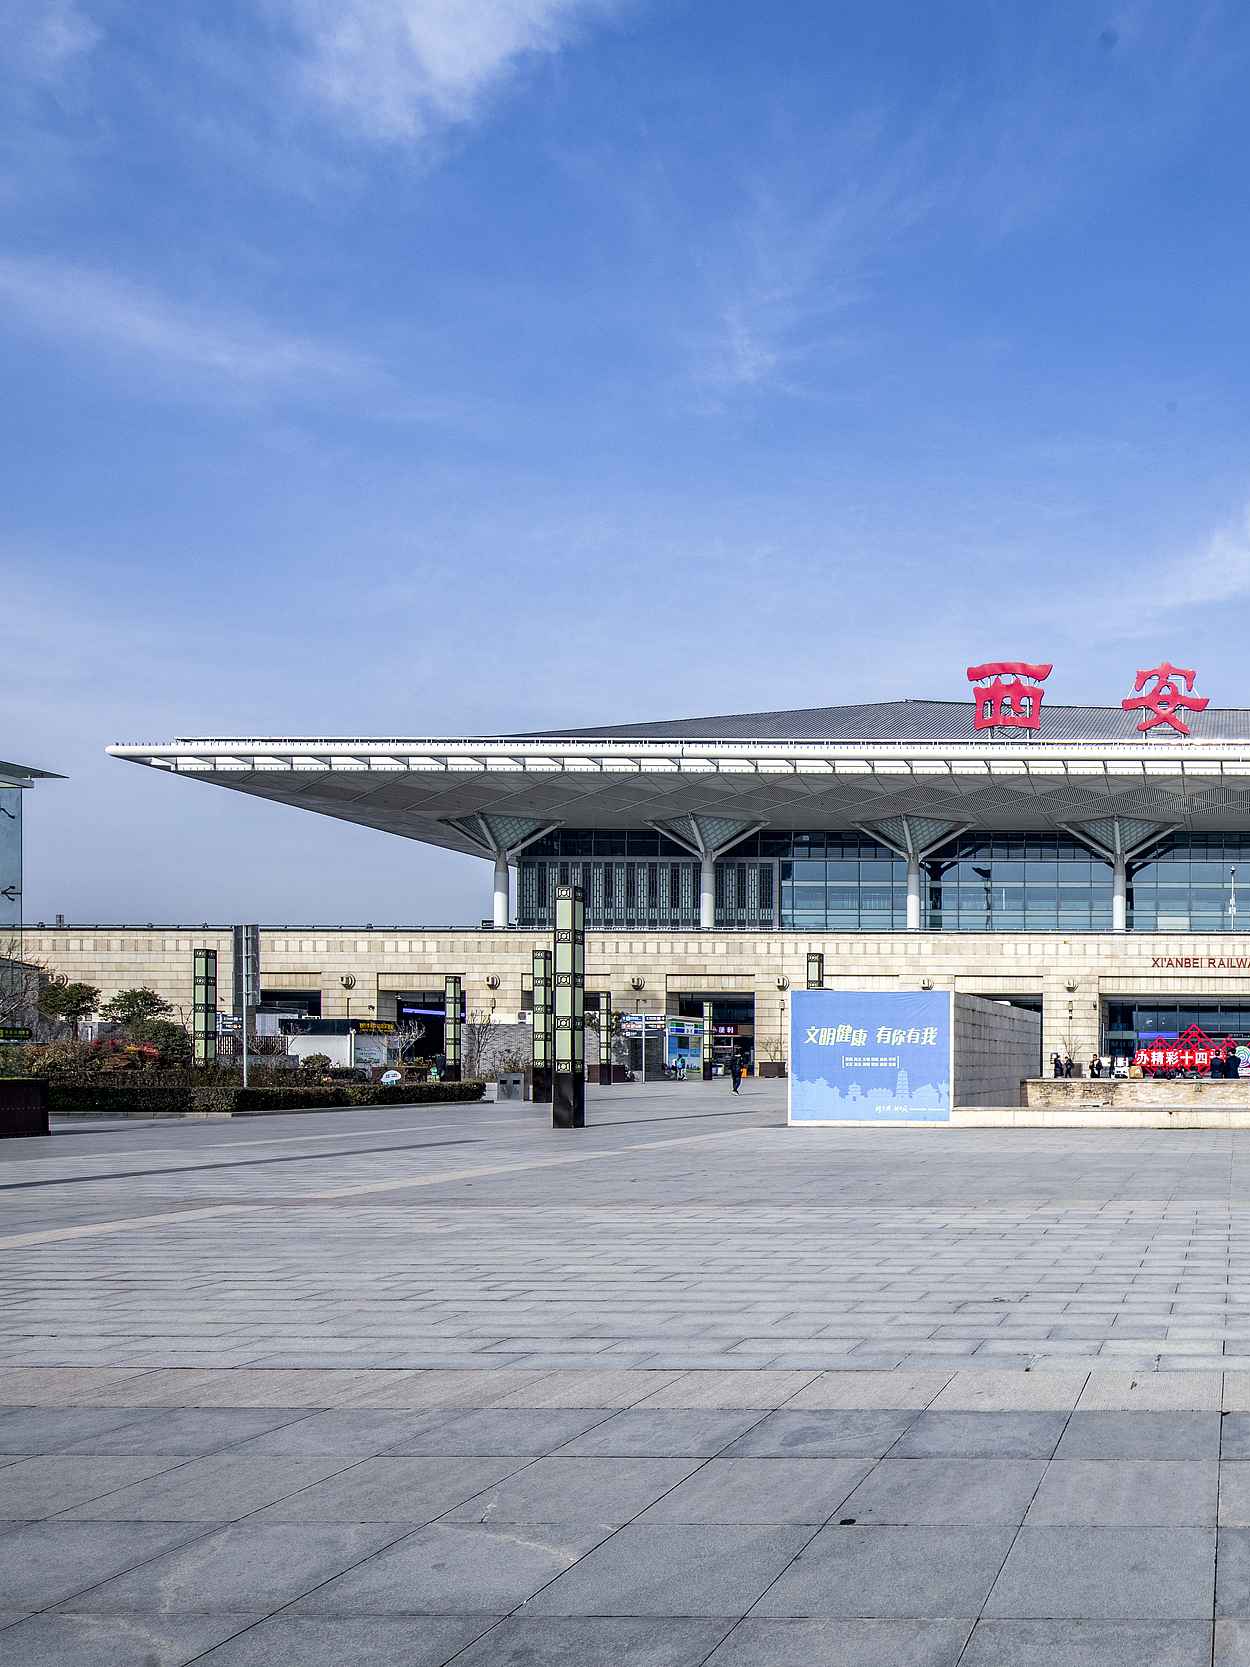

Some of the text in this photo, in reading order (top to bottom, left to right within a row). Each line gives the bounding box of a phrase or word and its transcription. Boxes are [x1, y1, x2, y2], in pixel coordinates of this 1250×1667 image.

[1151, 957, 1203, 968] XI'ANBEI
[803, 1024, 938, 1047] 文明健康 有你有我
